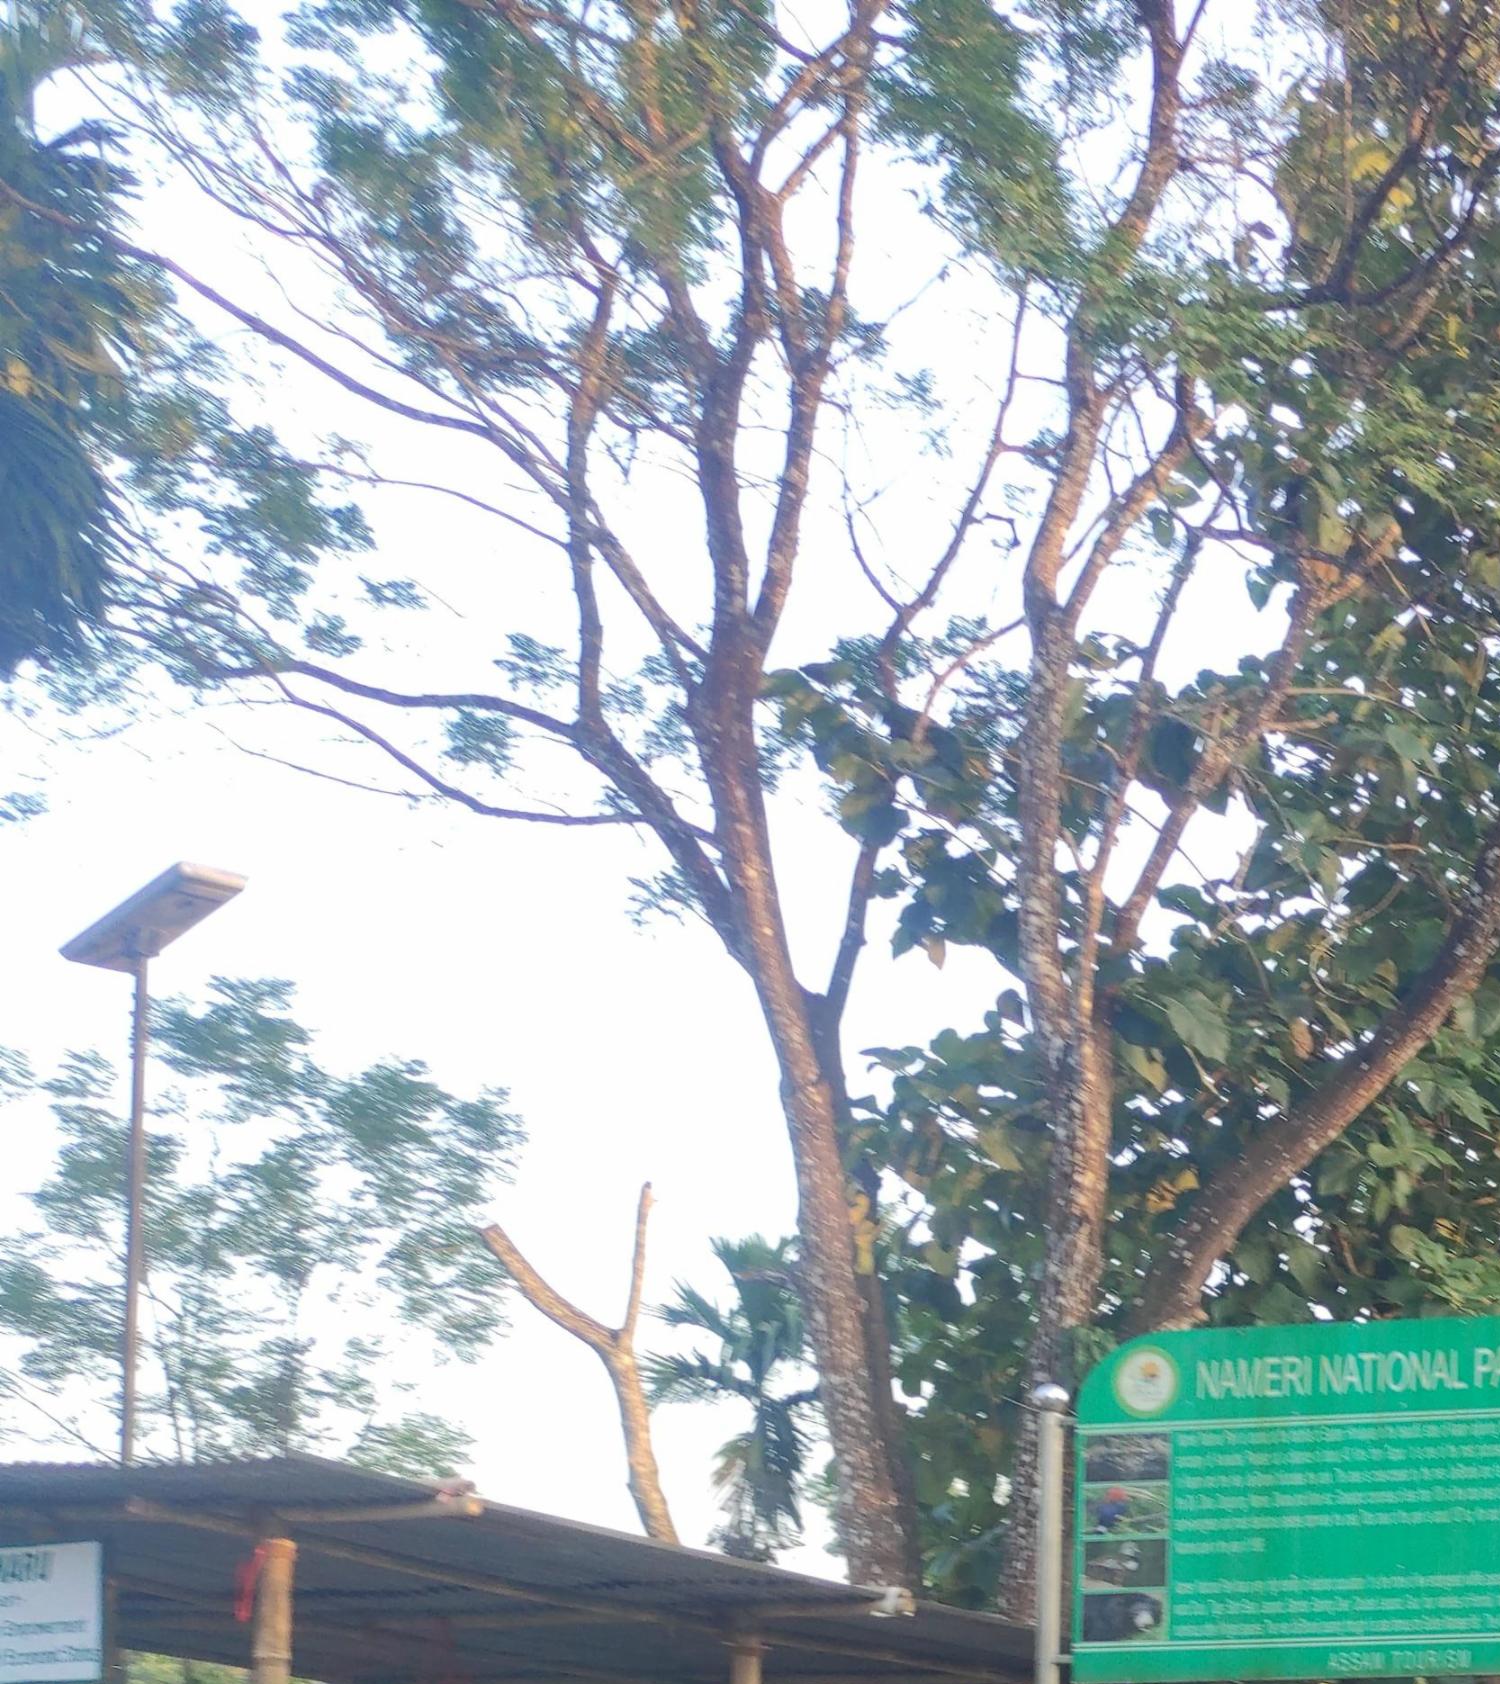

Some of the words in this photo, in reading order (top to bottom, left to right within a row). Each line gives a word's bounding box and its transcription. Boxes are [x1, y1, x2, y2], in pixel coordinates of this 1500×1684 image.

[1196, 1356, 1313, 1400] NAMERI
[1319, 1348, 1469, 1396] NATIONAL
[1328, 1651, 1386, 1671] ASSAM
[1391, 1650, 1472, 1670] TOURISM
